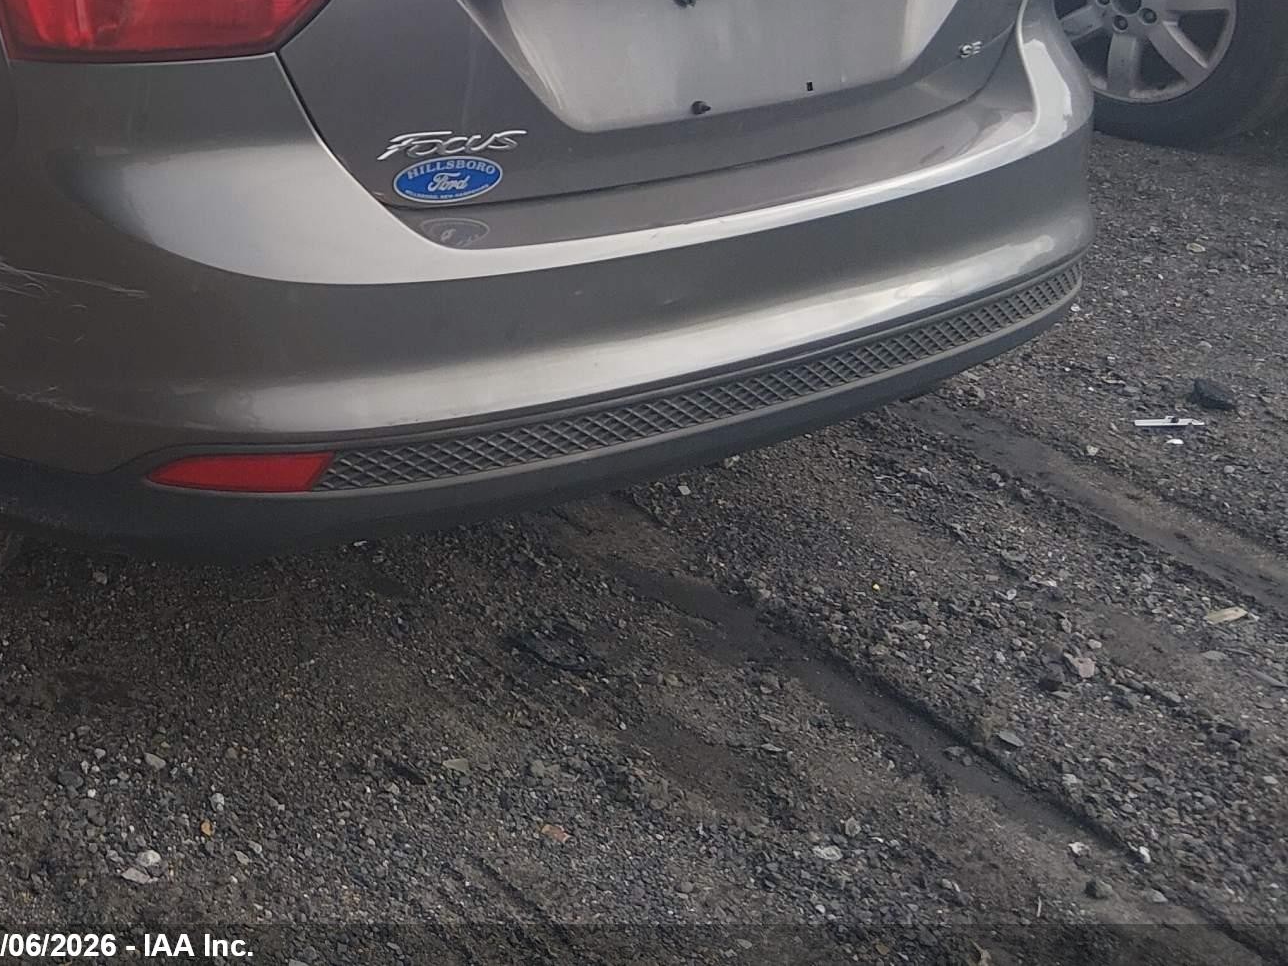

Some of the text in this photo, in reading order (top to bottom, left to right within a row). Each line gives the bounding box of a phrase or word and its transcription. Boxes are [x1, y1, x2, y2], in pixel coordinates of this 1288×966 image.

[960, 40, 982, 59] SE
[406, 159, 496, 180] HILLSBORO
[428, 172, 471, 192] Ford
